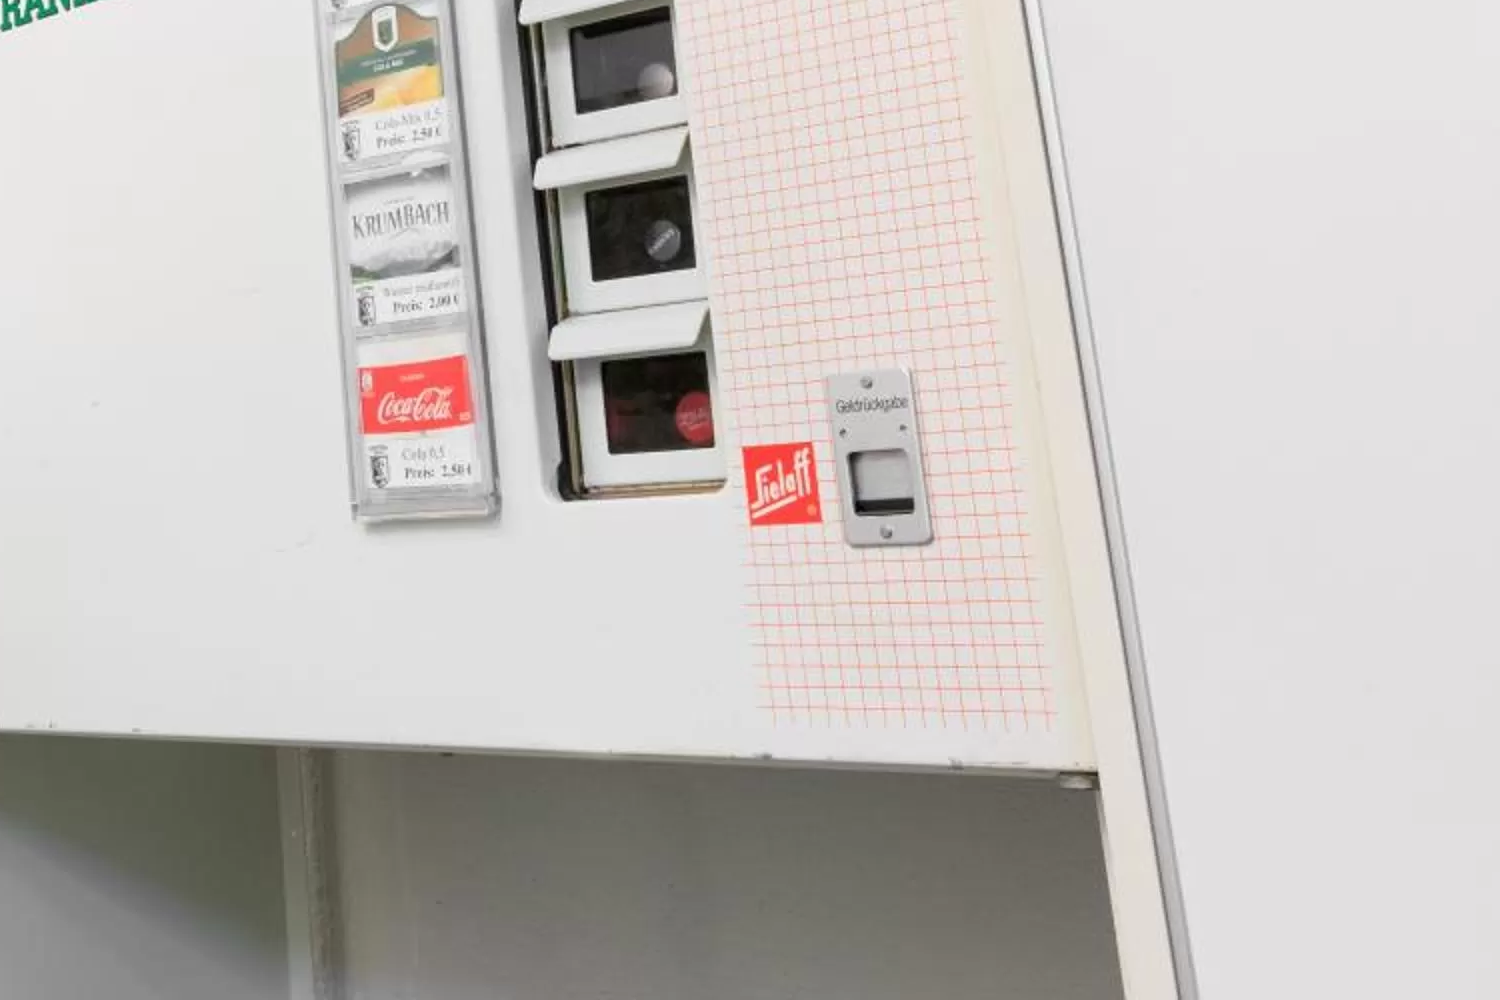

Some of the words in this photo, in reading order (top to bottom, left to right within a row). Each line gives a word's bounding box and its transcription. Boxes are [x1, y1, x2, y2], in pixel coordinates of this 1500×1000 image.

[351, 200, 449, 240] KRUMBACH
[392, 299, 422, 314] Preis:
[835, 396, 909, 414] Geldrückgabe
[404, 466, 435, 480] Preis:
[751, 447, 812, 511] Sielaff
